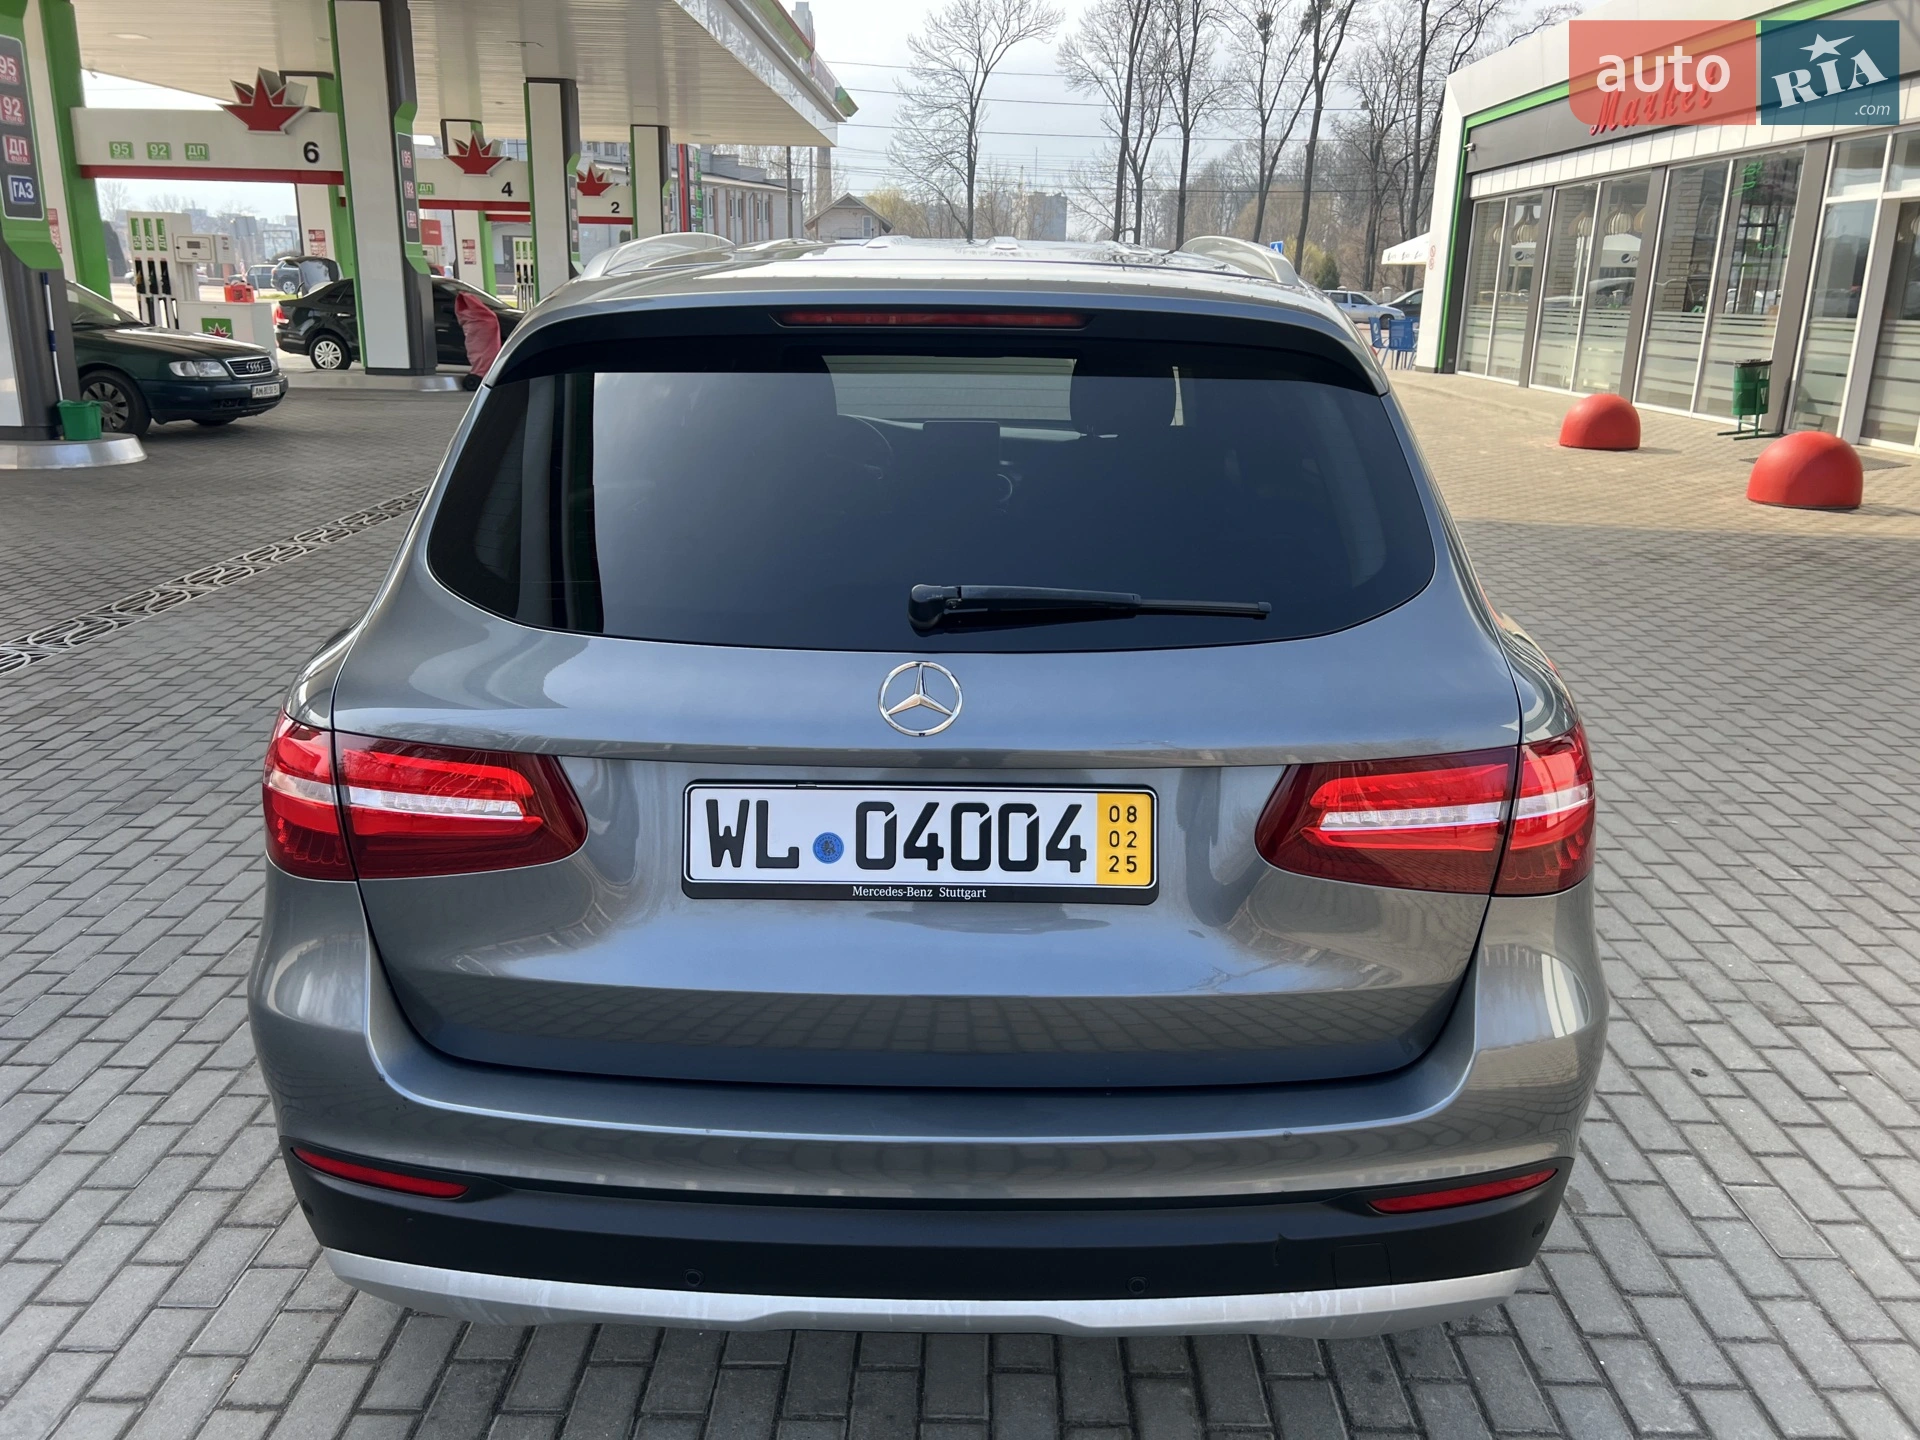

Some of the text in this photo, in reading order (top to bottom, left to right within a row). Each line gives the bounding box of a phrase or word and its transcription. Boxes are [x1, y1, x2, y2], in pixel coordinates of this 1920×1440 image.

[0, 54, 17, 77] 95
[3, 96, 22, 117] 92
[9, 138, 28, 156] ДП
[112, 143, 206, 156] 95 92 ДП
[303, 141, 320, 164] 6
[12, 181, 34, 199] ГАЗ
[419, 183, 433, 192] ДП
[501, 181, 513, 197] 4
[611, 201, 620, 214] 2
[1109, 805, 1138, 823] 08
[705, 799, 800, 869] WL
[855, 801, 1087, 873] 04004
[1109, 830, 1138, 848] 02
[1108, 855, 1138, 873] 25
[852, 885, 987, 900] Mercedes-Benz Stuttgart
